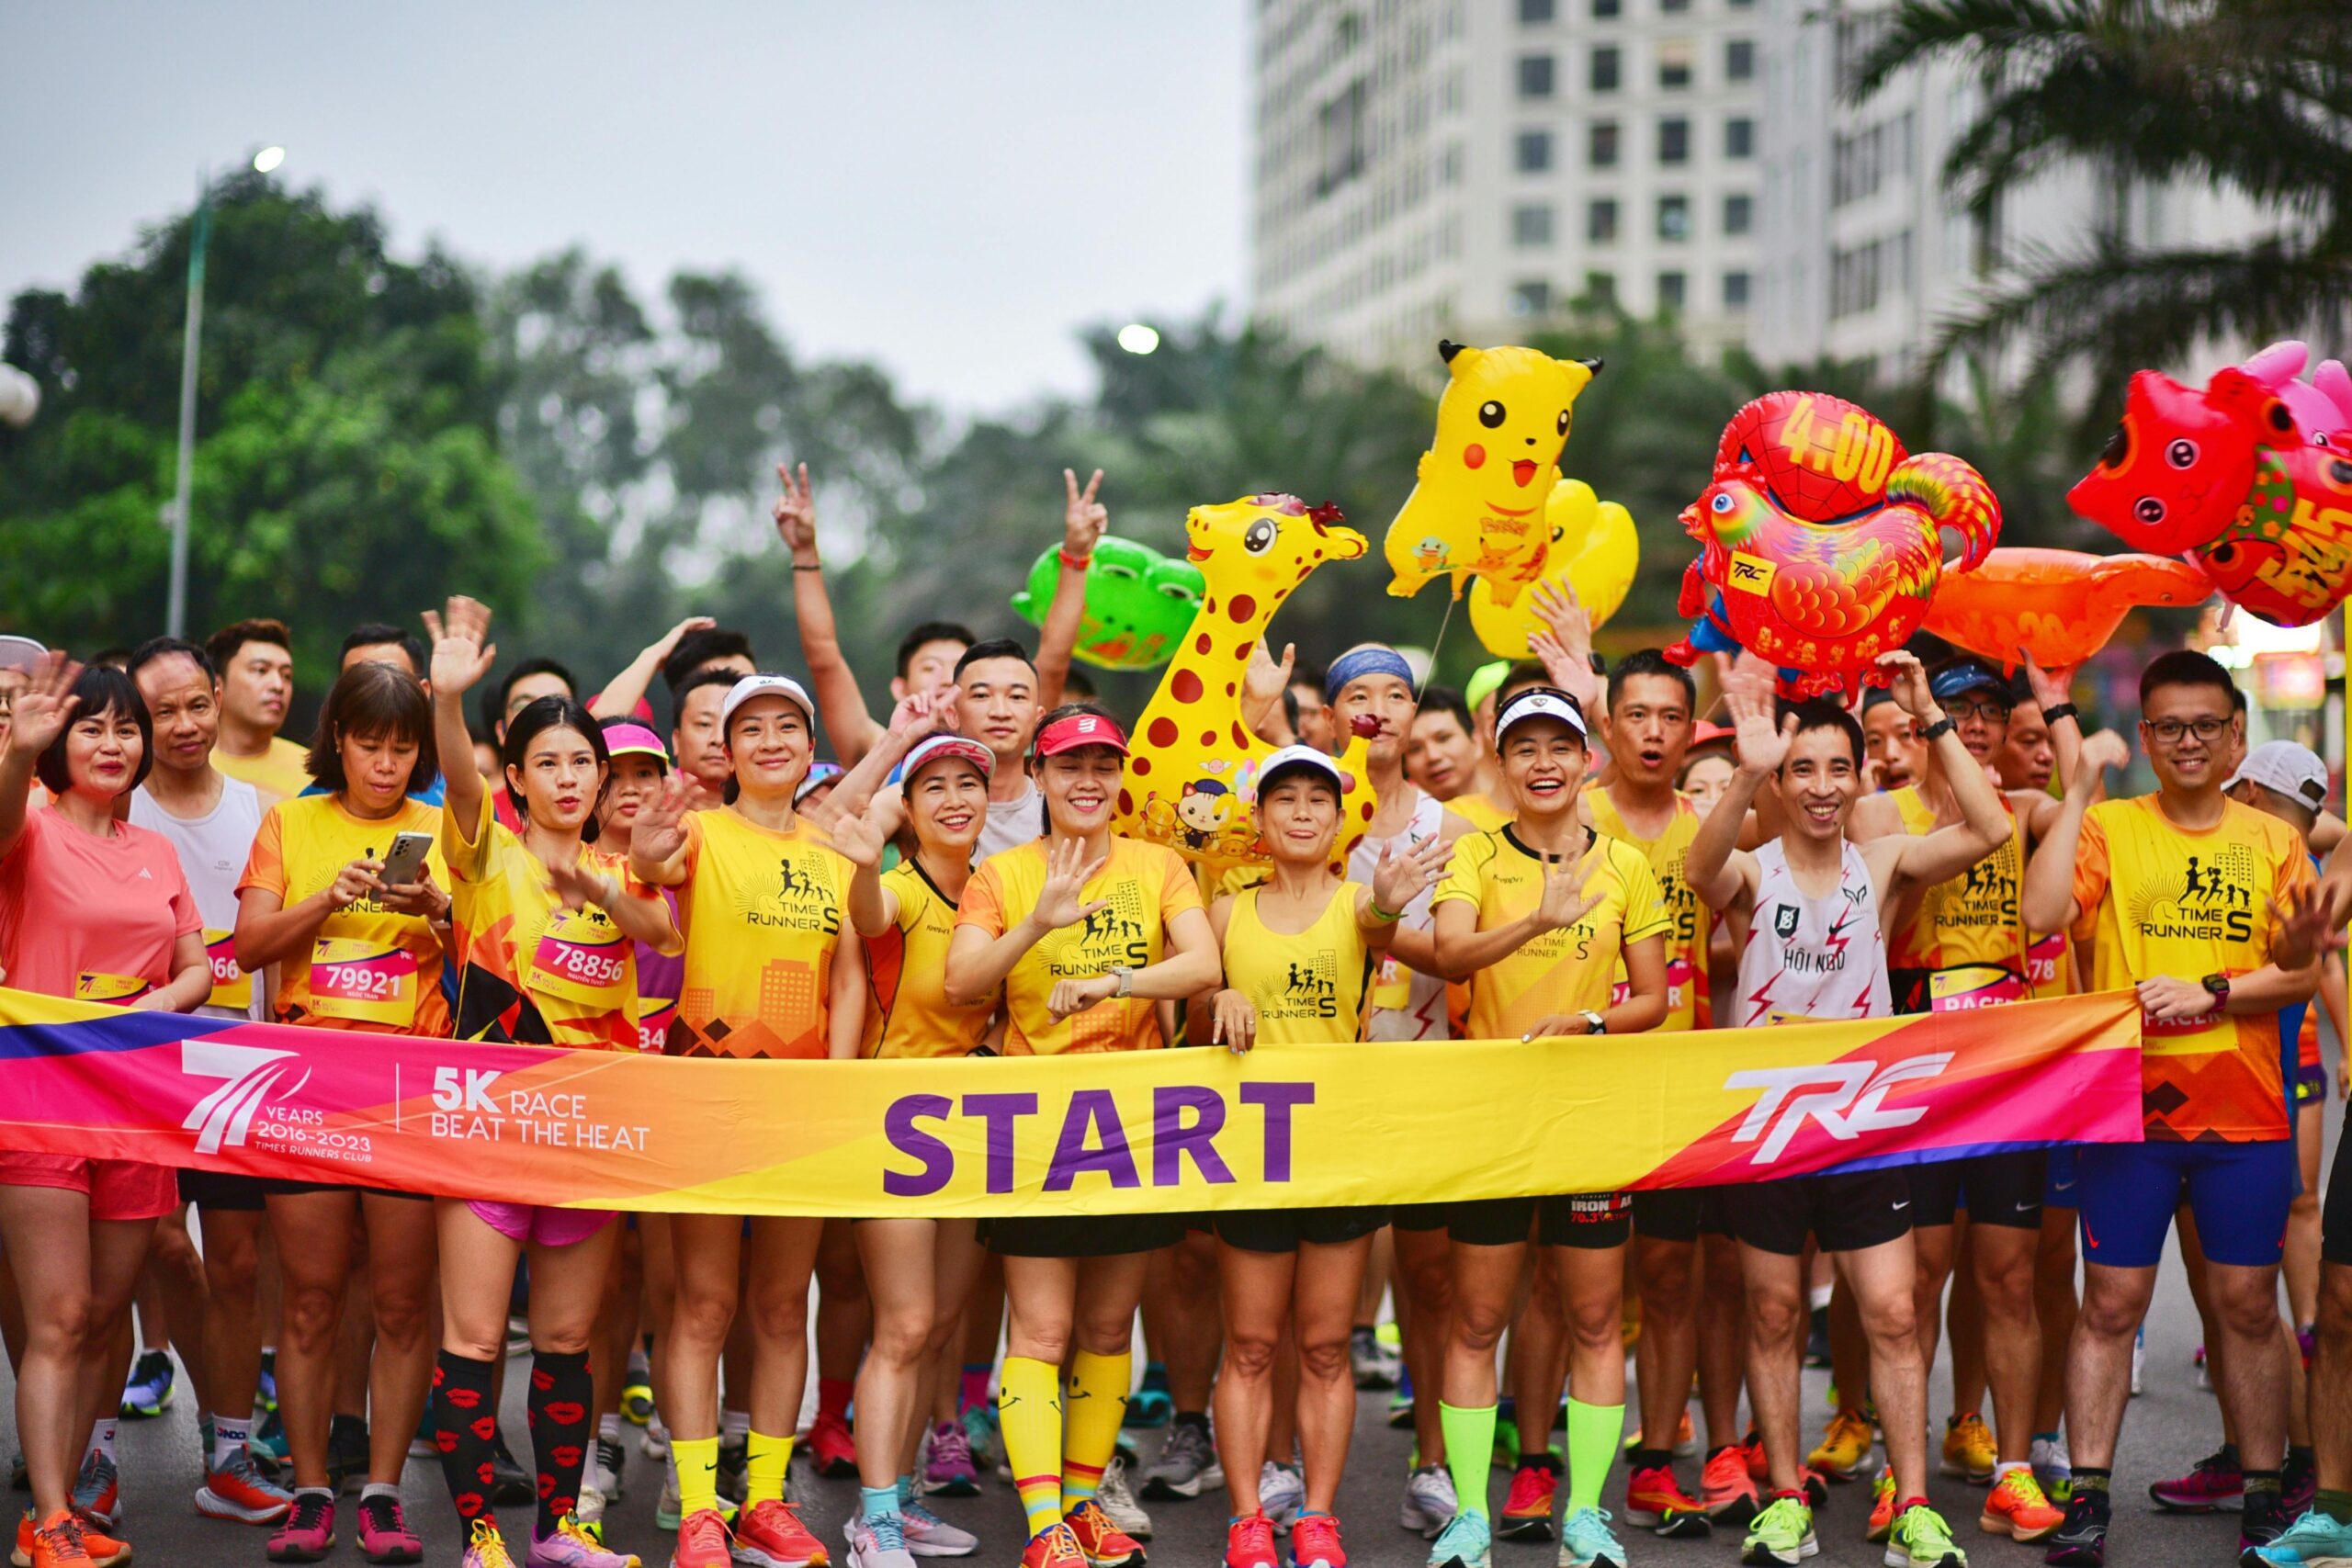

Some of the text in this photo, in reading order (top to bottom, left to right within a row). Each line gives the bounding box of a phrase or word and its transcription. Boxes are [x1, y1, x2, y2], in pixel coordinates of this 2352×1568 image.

[1779, 396, 1894, 494] 4:00
[1734, 560, 1768, 581] TRC
[779, 900, 820, 915] TIME
[1963, 899, 1999, 911] TIME
[2177, 907, 2222, 922] TIME
[747, 911, 820, 931] RUNNER
[823, 907, 840, 936] S
[1934, 913, 1999, 927] RUNNER
[2225, 910, 2253, 943] S
[2141, 922, 2222, 940] RUNNER
[1081, 943, 1122, 959] TIME
[1517, 947, 1557, 958] RUNNER
[1544, 937, 1566, 947] TIME
[1575, 941, 1589, 960] S
[551, 942, 625, 982] 78856
[1125, 942, 1148, 969] S
[1783, 947, 1811, 974] HỘI
[325, 964, 401, 998] 79921
[1285, 998, 1317, 1007] TIME
[1318, 997, 1337, 1018] S
[1261, 1009, 1317, 1020] RUNNER
[431, 1066, 587, 1120] 5K RACE
[266, 1105, 323, 1126] YEARS
[1722, 1051, 1956, 1165] TRC
[256, 1120, 371, 1152] 2016-2023
[431, 1112, 650, 1151] BEAT THE HEAT
[883, 1081, 1316, 1197] START
[254, 1140, 373, 1164] TIMES RUNNERS CLUB
